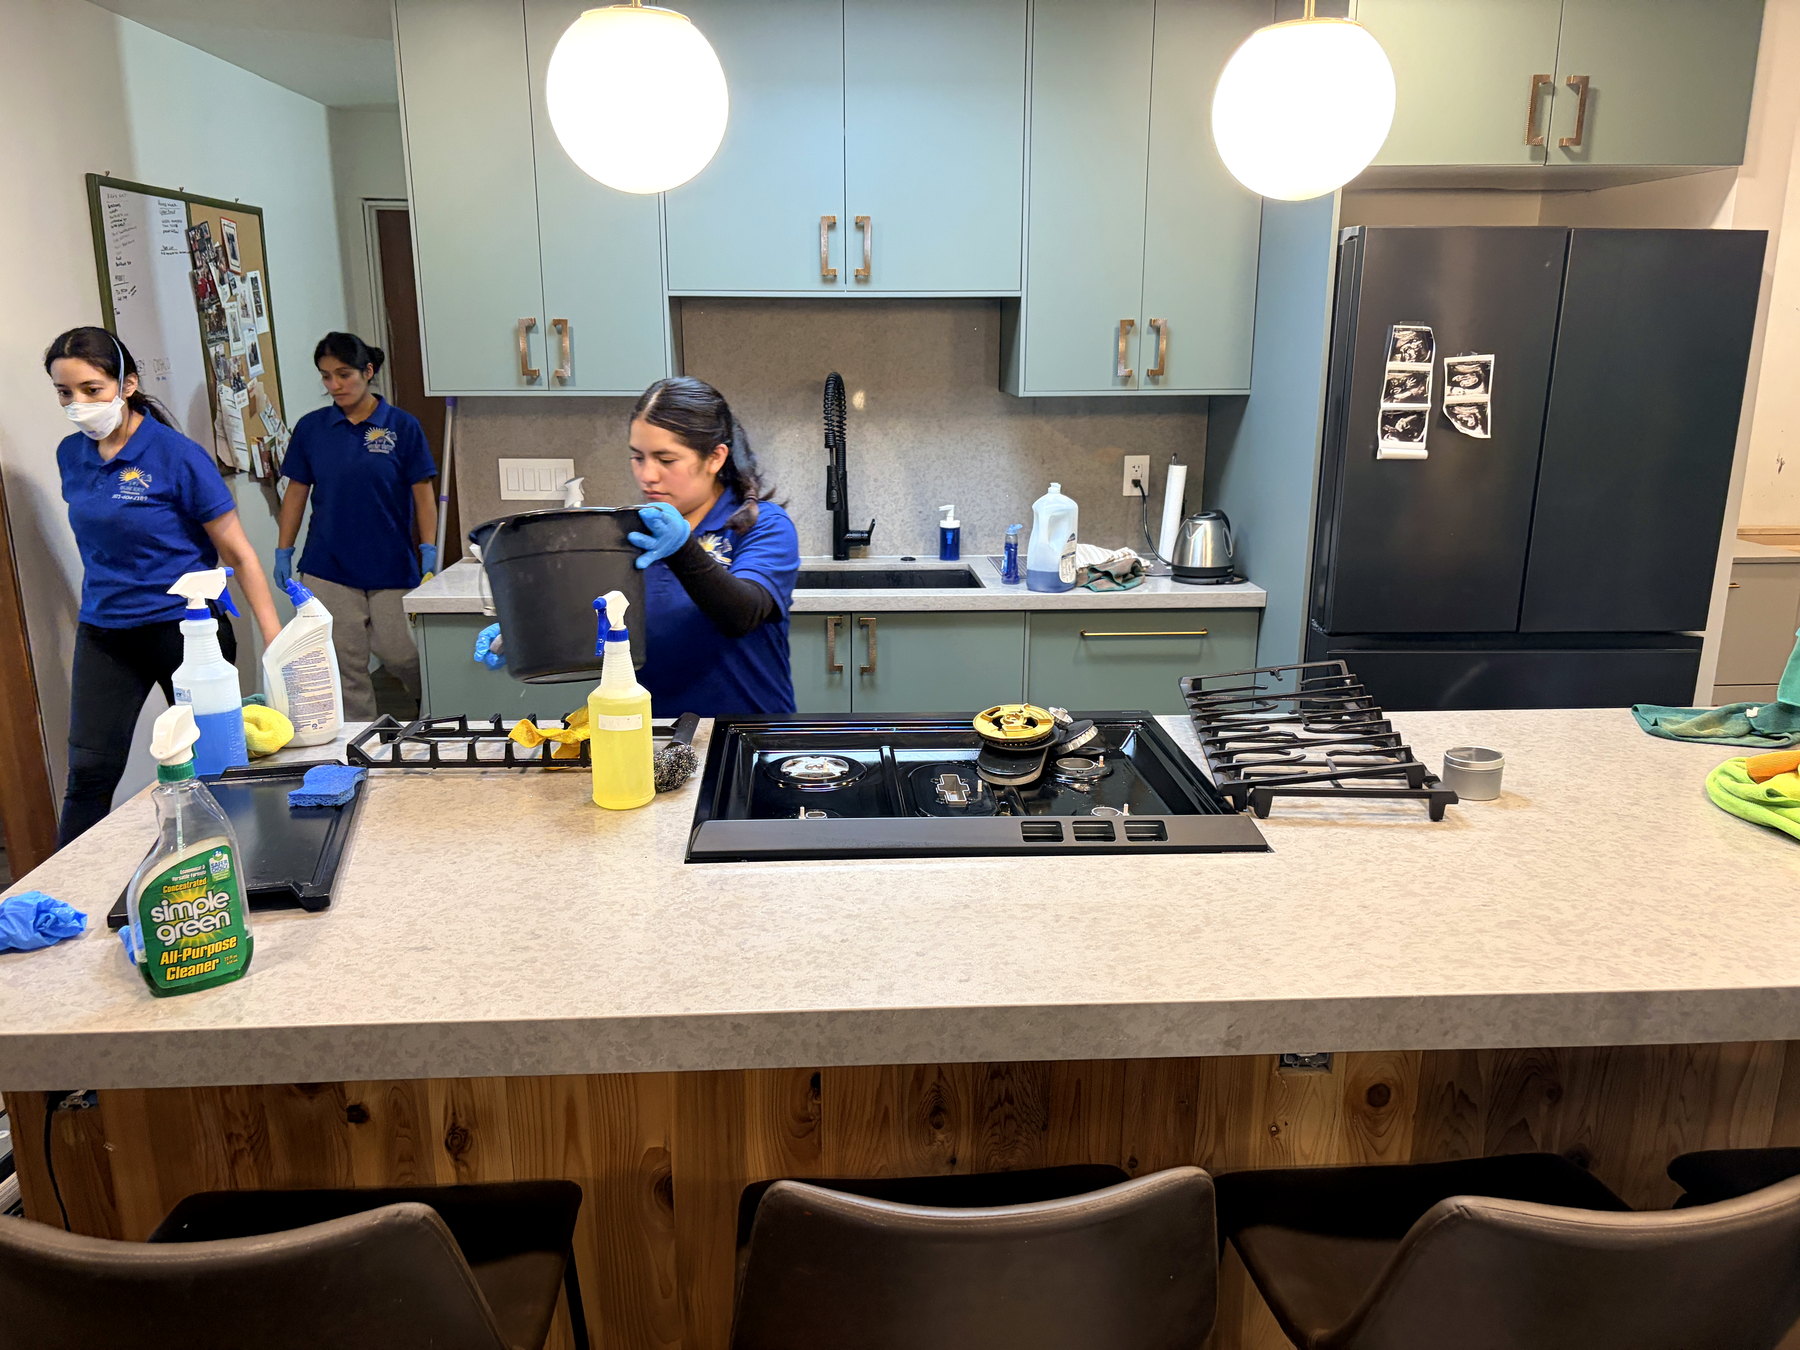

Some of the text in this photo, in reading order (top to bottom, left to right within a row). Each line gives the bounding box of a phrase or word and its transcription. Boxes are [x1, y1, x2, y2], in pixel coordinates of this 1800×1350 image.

[163, 877, 207, 893] Concentrated
[150, 890, 230, 923] simple
[156, 911, 231, 947] green
[160, 936, 237, 966] All-Purpose
[166, 958, 219, 981] Cleaner
